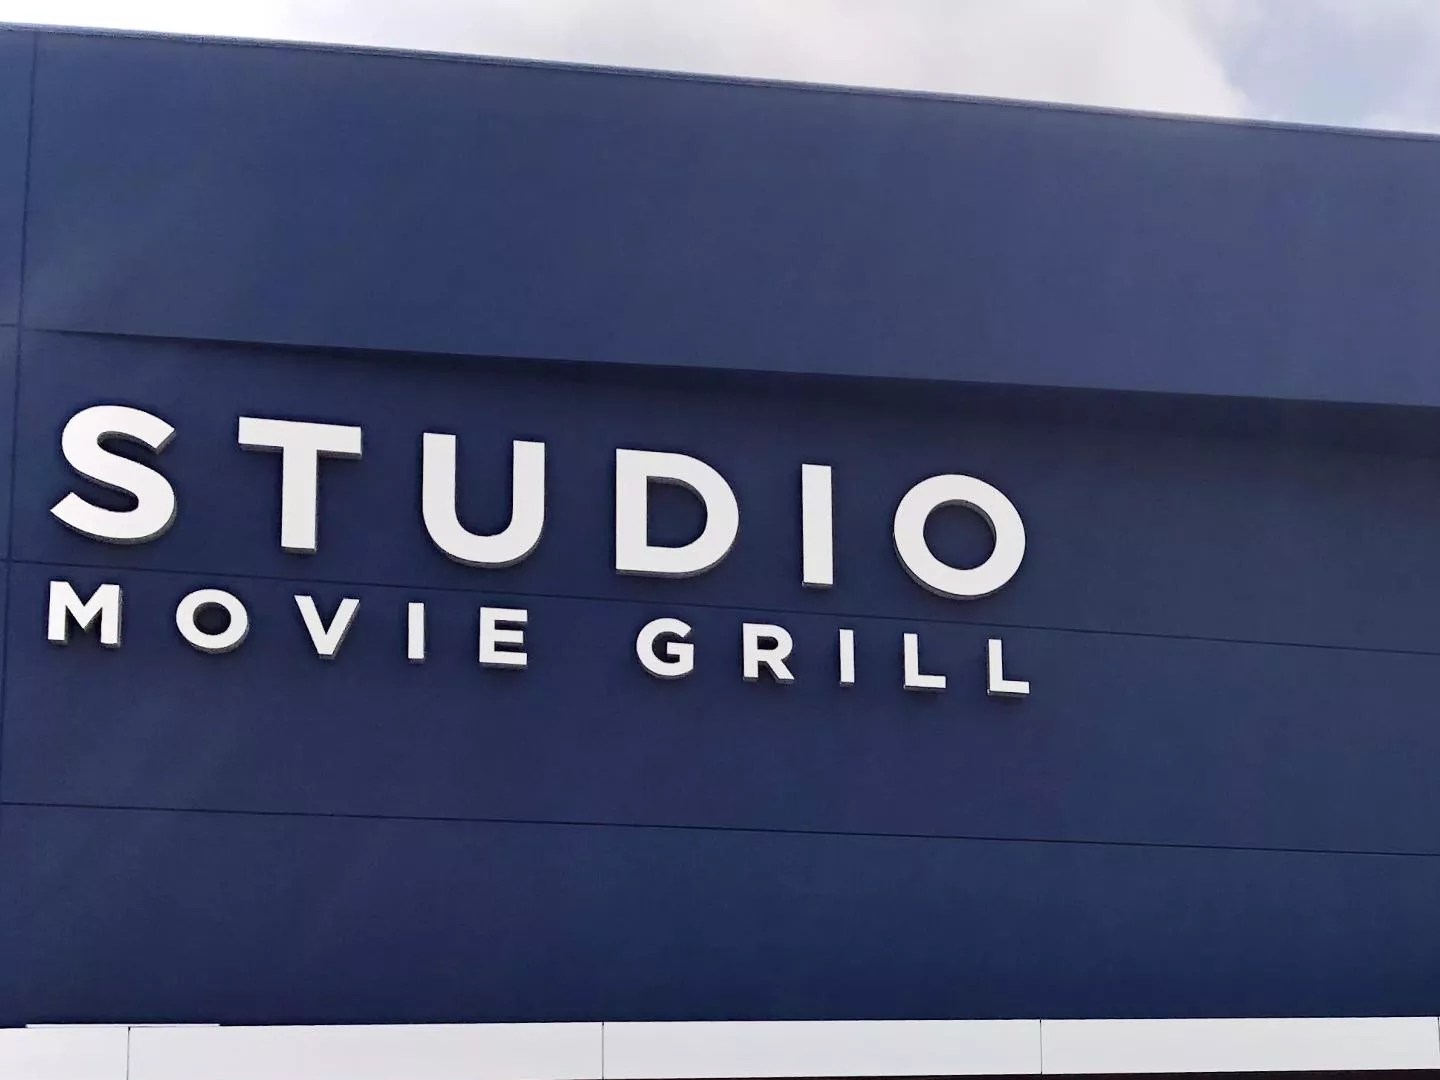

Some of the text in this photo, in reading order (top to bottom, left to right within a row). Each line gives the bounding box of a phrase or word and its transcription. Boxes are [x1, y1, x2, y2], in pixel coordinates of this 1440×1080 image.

[50, 405, 1026, 598] STUDIO
[47, 580, 1031, 697] MOVIE GRILL
